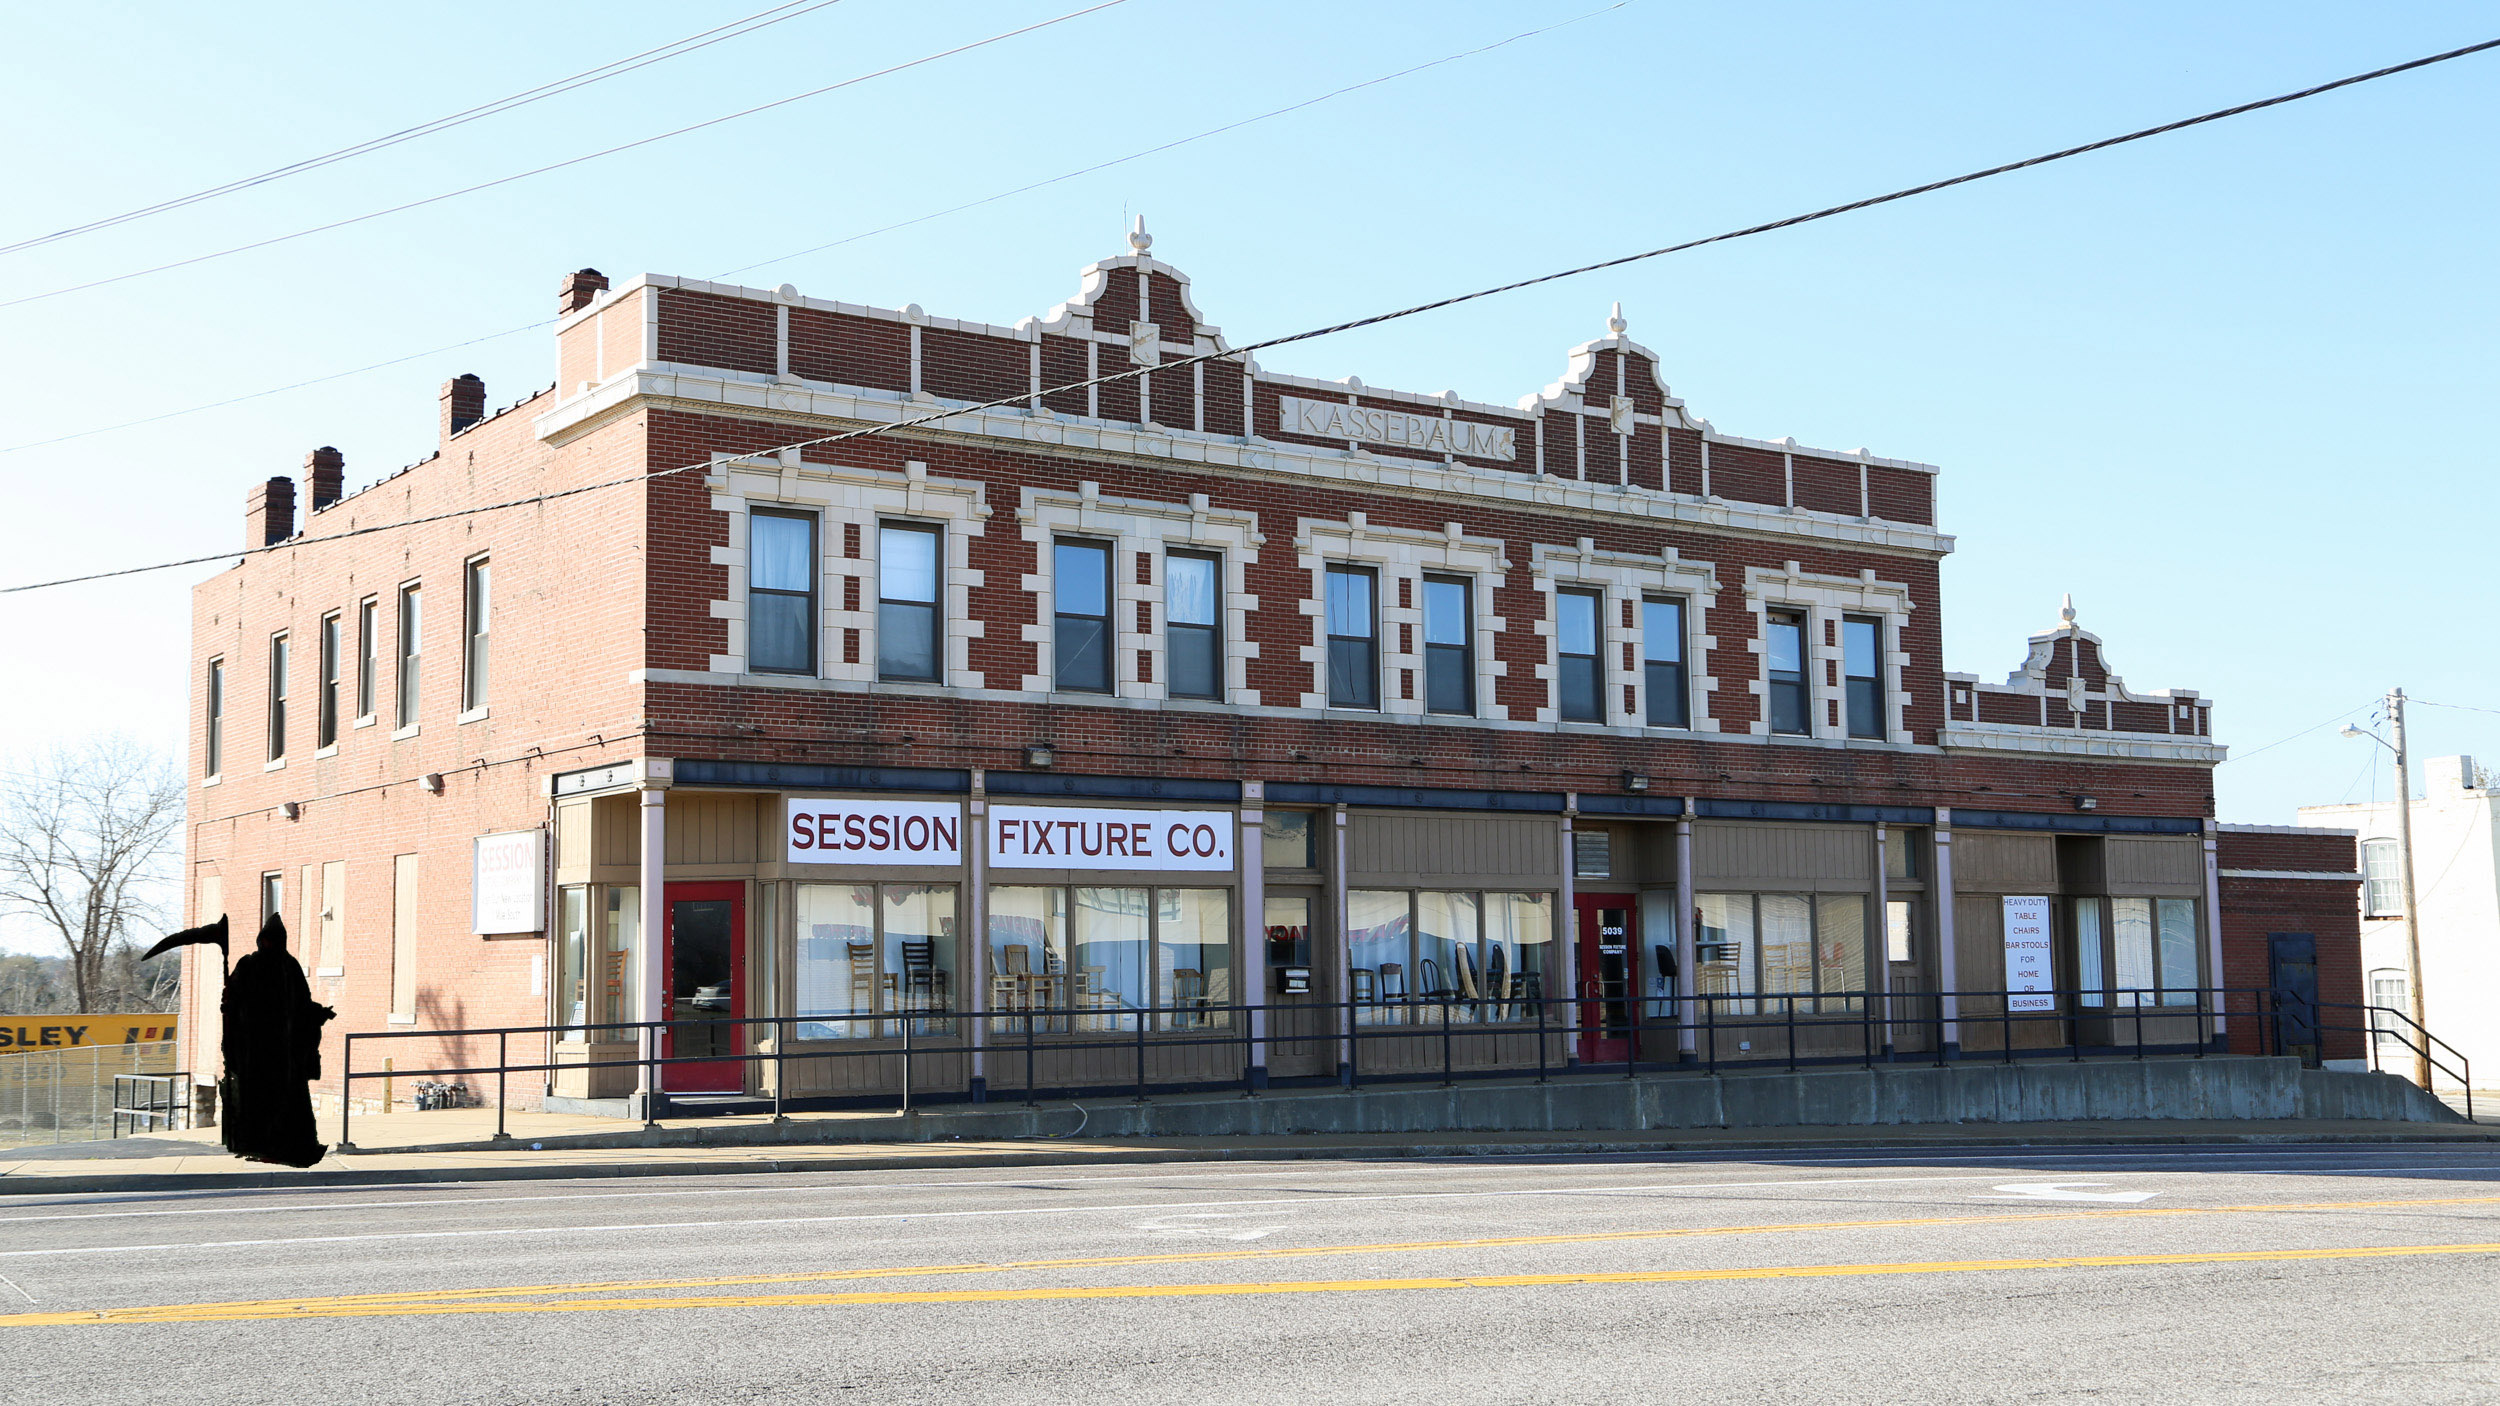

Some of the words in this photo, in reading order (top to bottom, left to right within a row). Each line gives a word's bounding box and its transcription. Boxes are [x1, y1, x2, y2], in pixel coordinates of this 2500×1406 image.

[1299, 400, 1496, 457] KASSEBAUM
[792, 813, 958, 852] SESSION
[998, 819, 1153, 858] FIXTURE
[1167, 822, 1225, 859] CO.
[481, 842, 534, 873] SESSION
[2003, 898, 2027, 906] HEAVY
[2028, 898, 2047, 906] DUTY
[2014, 912, 2037, 920] TABLE
[1602, 927, 1623, 935] 5039
[2013, 927, 2040, 935] CHAIRS
[2005, 941, 2020, 949] BAR
[2021, 941, 2049, 949] STOOLS
[2018, 970, 2039, 978] HOME
[2012, 999, 2049, 1008] BUSINESS
